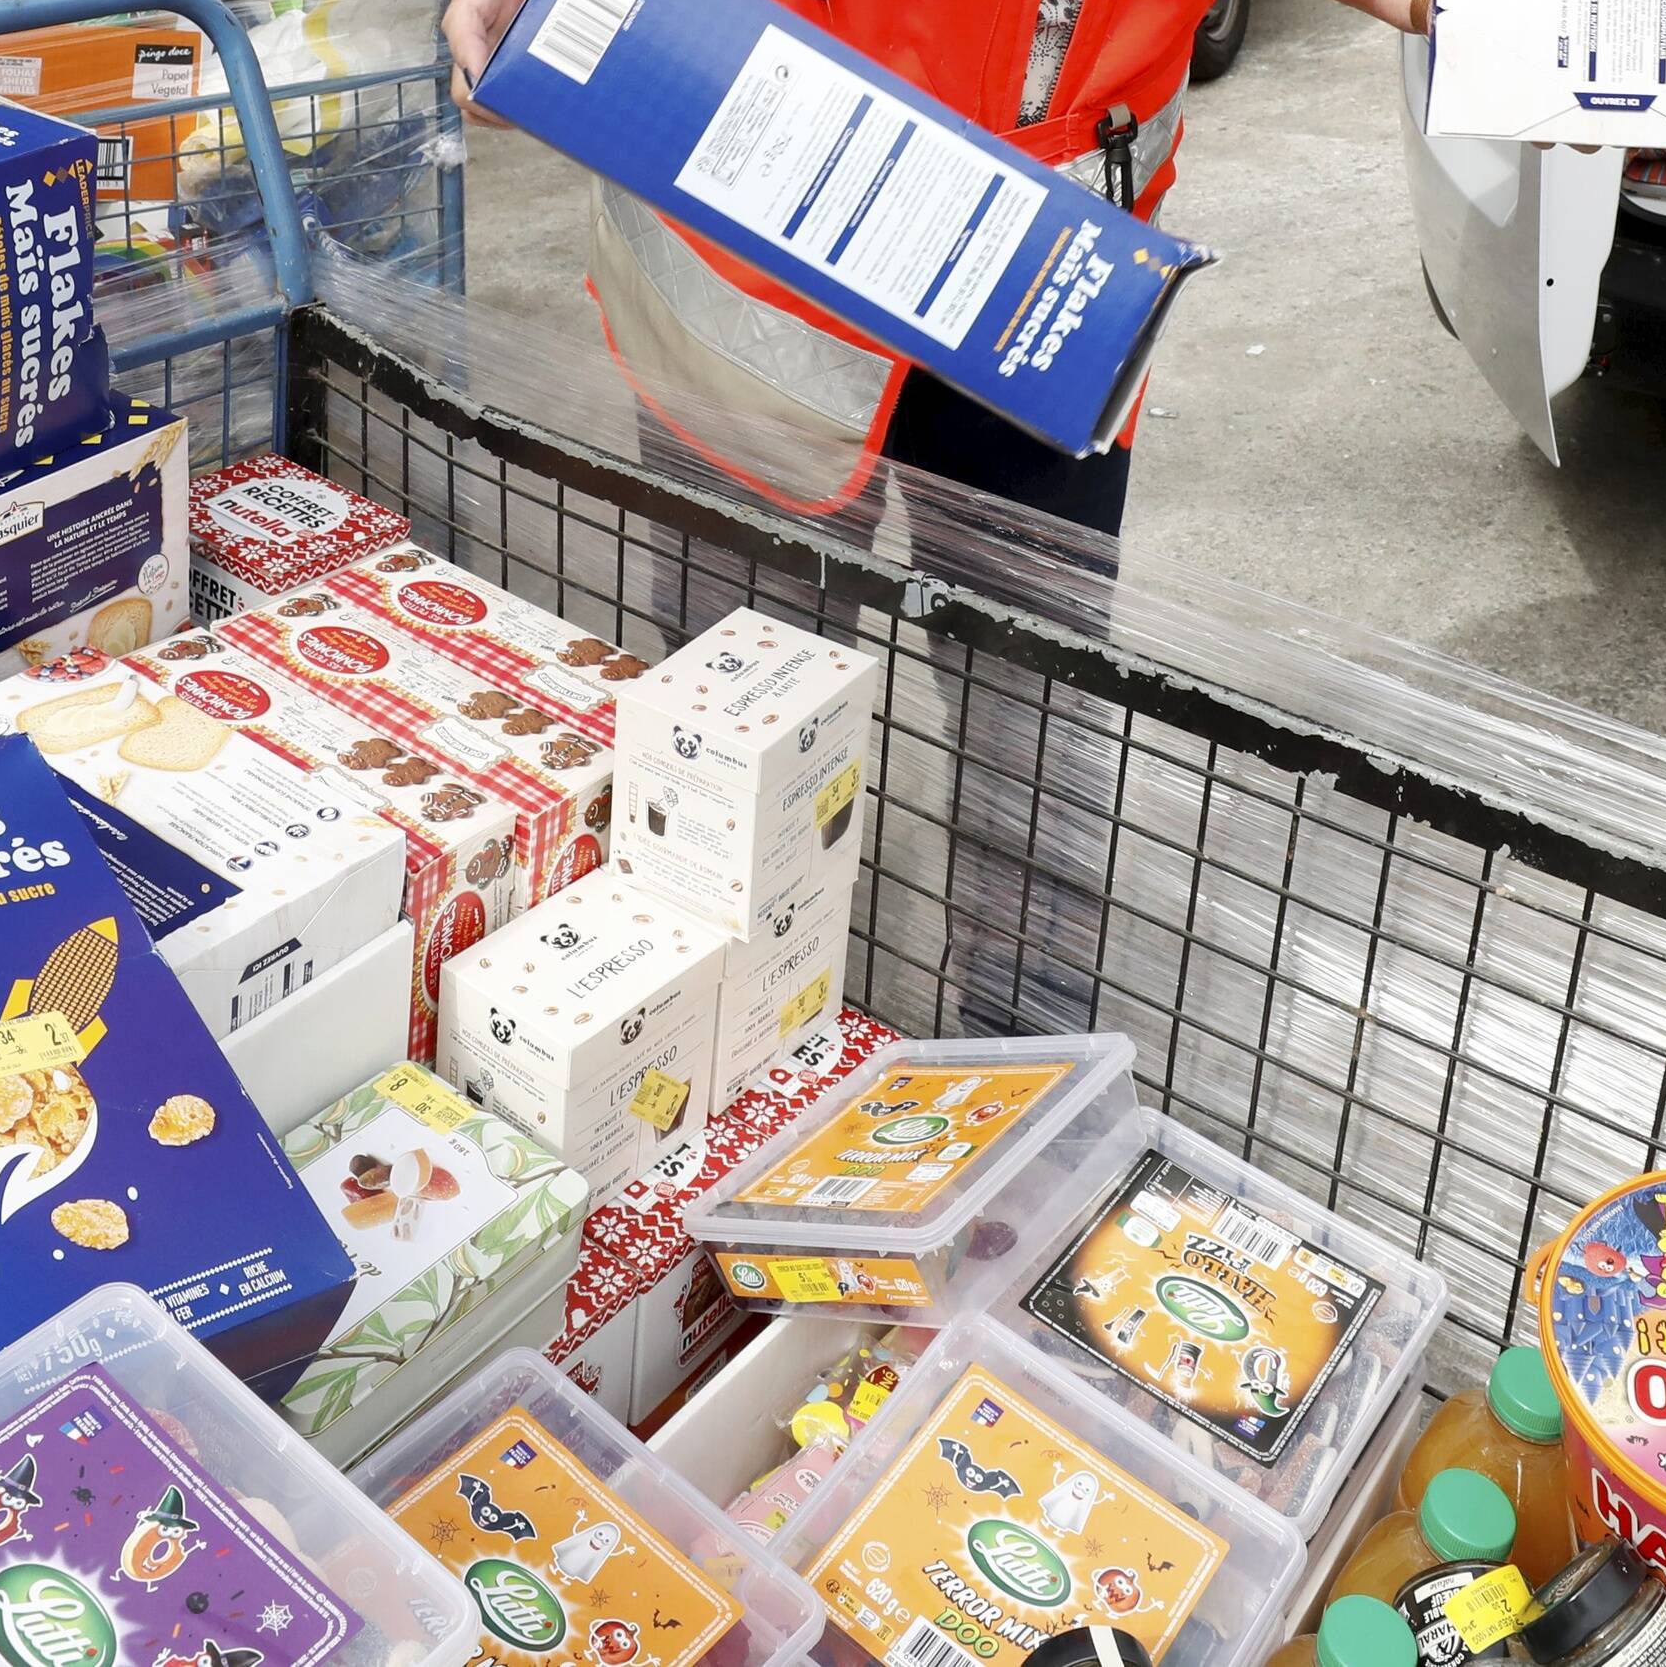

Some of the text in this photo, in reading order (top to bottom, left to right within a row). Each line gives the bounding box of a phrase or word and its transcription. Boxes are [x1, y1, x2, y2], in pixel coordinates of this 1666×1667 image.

[0, 67, 37, 78] FOLHAS
[138, 46, 192, 64] pingo doce
[1, 76, 35, 86] SHEETS
[150, 83, 189, 98] Vegetal
[161, 68, 190, 82] Papel
[1589, 96, 1627, 107] OUVREZ
[1051, 217, 1104, 288] Maïs
[0, 293, 15, 330] maïs
[5, 178, 45, 449] Maïs sucrés
[42, 205, 84, 402] Flakes
[1031, 251, 1116, 373] Flakes
[998, 285, 1059, 378] sucrés
[1, 330, 16, 376] glacés
[0, 376, 14, 392] au
[60, 498, 133, 538] HISTOIRE ANCRÉE DANS
[217, 499, 293, 539] nutella
[242, 485, 326, 530] RECETTES
[267, 484, 335, 521] COFFRET
[63, 510, 127, 546] NATURE TEMPS
[722, 647, 817, 718] ESPRESSO INTENSE
[705, 746, 749, 771] columbus
[782, 771, 820, 812] ESPRESSO
[818, 745, 850, 782] INTENSE
[8, 881, 56, 902] sucre
[261, 944, 290, 968] OUVREZ
[560, 935, 599, 962] columbus
[761, 935, 821, 994] L'ESPRESSO
[565, 938, 655, 1001] L'ESPRESSO
[648, 989, 682, 1017] columbus
[518, 1034, 556, 1063] columbus
[608, 1044, 678, 1107] L'ESPRESSO
[836, 1149, 890, 1165] TERROR
[242, 1260, 270, 1279] RICHE
[1186, 1234, 1254, 1276] FIZZ
[165, 1283, 210, 1309] VITAMINES
[237, 1269, 287, 1298] EN CALCIUM
[1183, 1250, 1277, 1315] HALLO
[175, 1305, 194, 1323] FER
[973, 1528, 1059, 1597] Lutti
[470, 1570, 554, 1639] Lutti
[864, 1577, 891, 1609] 620
[922, 1558, 1052, 1652] TERROR MIX
[934, 1605, 1000, 1659] DOO
